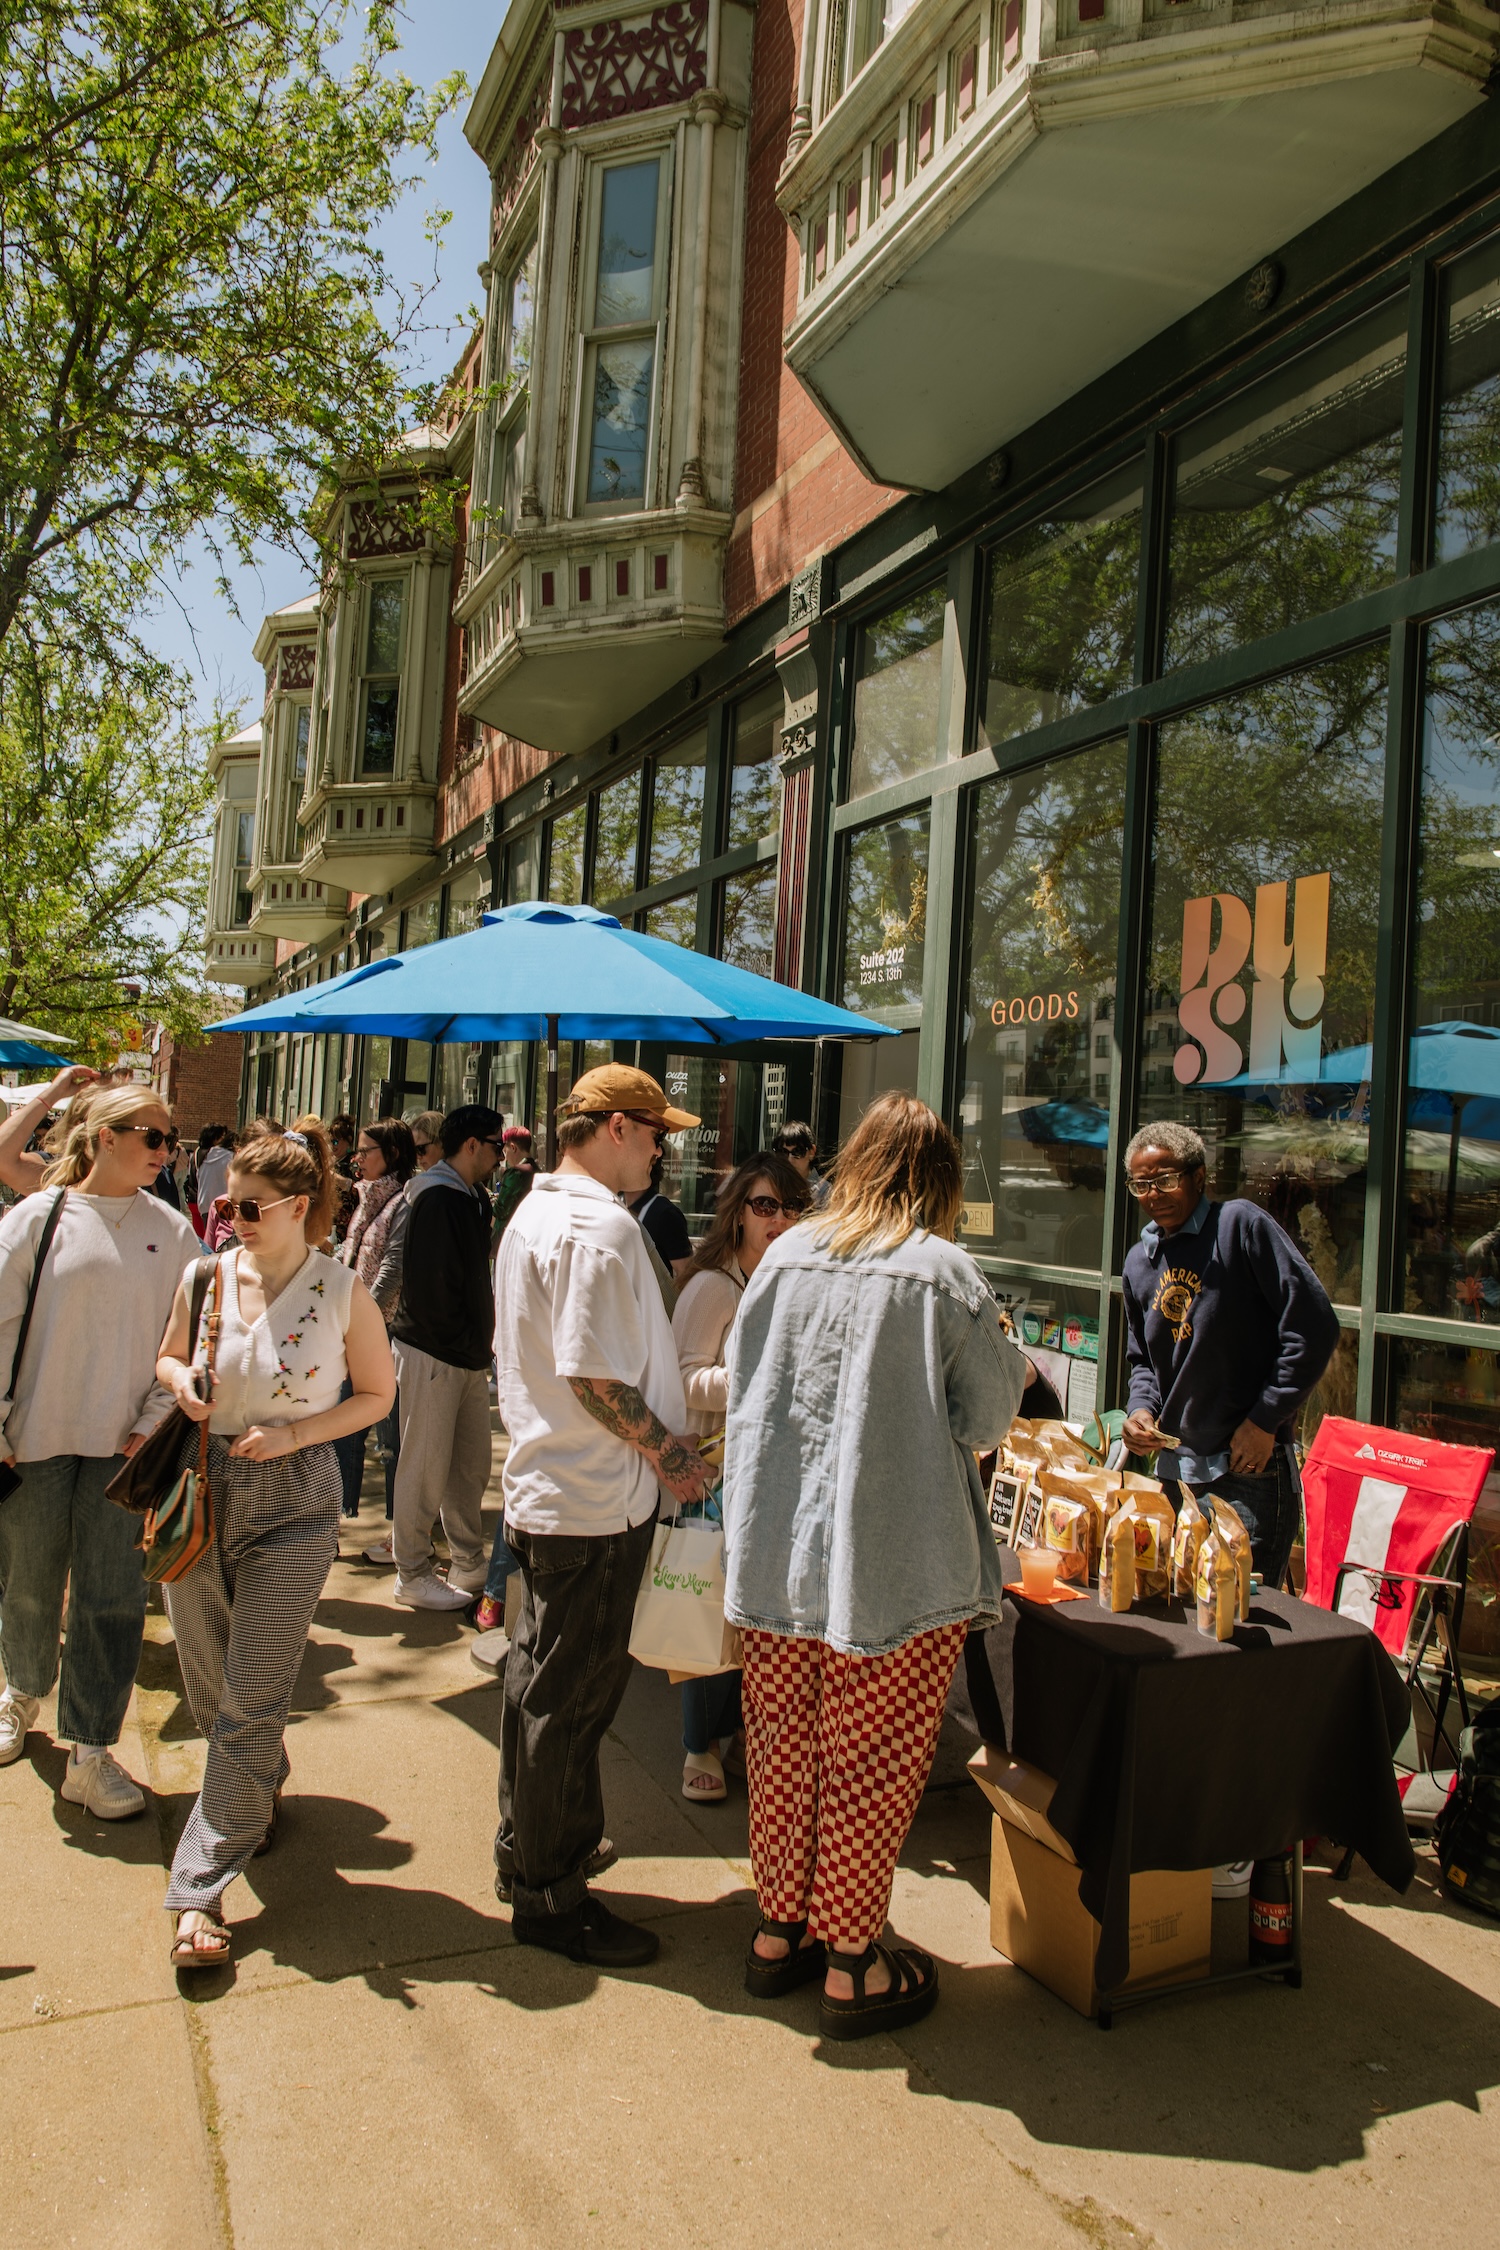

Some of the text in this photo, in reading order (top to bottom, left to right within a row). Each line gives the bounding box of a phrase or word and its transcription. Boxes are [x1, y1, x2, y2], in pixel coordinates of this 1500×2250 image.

[859, 947, 905, 970] Suite 202
[860, 968, 902, 986] 1234 S. 13th
[991, 991, 1079, 1026] GOODS
[961, 1210, 988, 1227] OPEN
